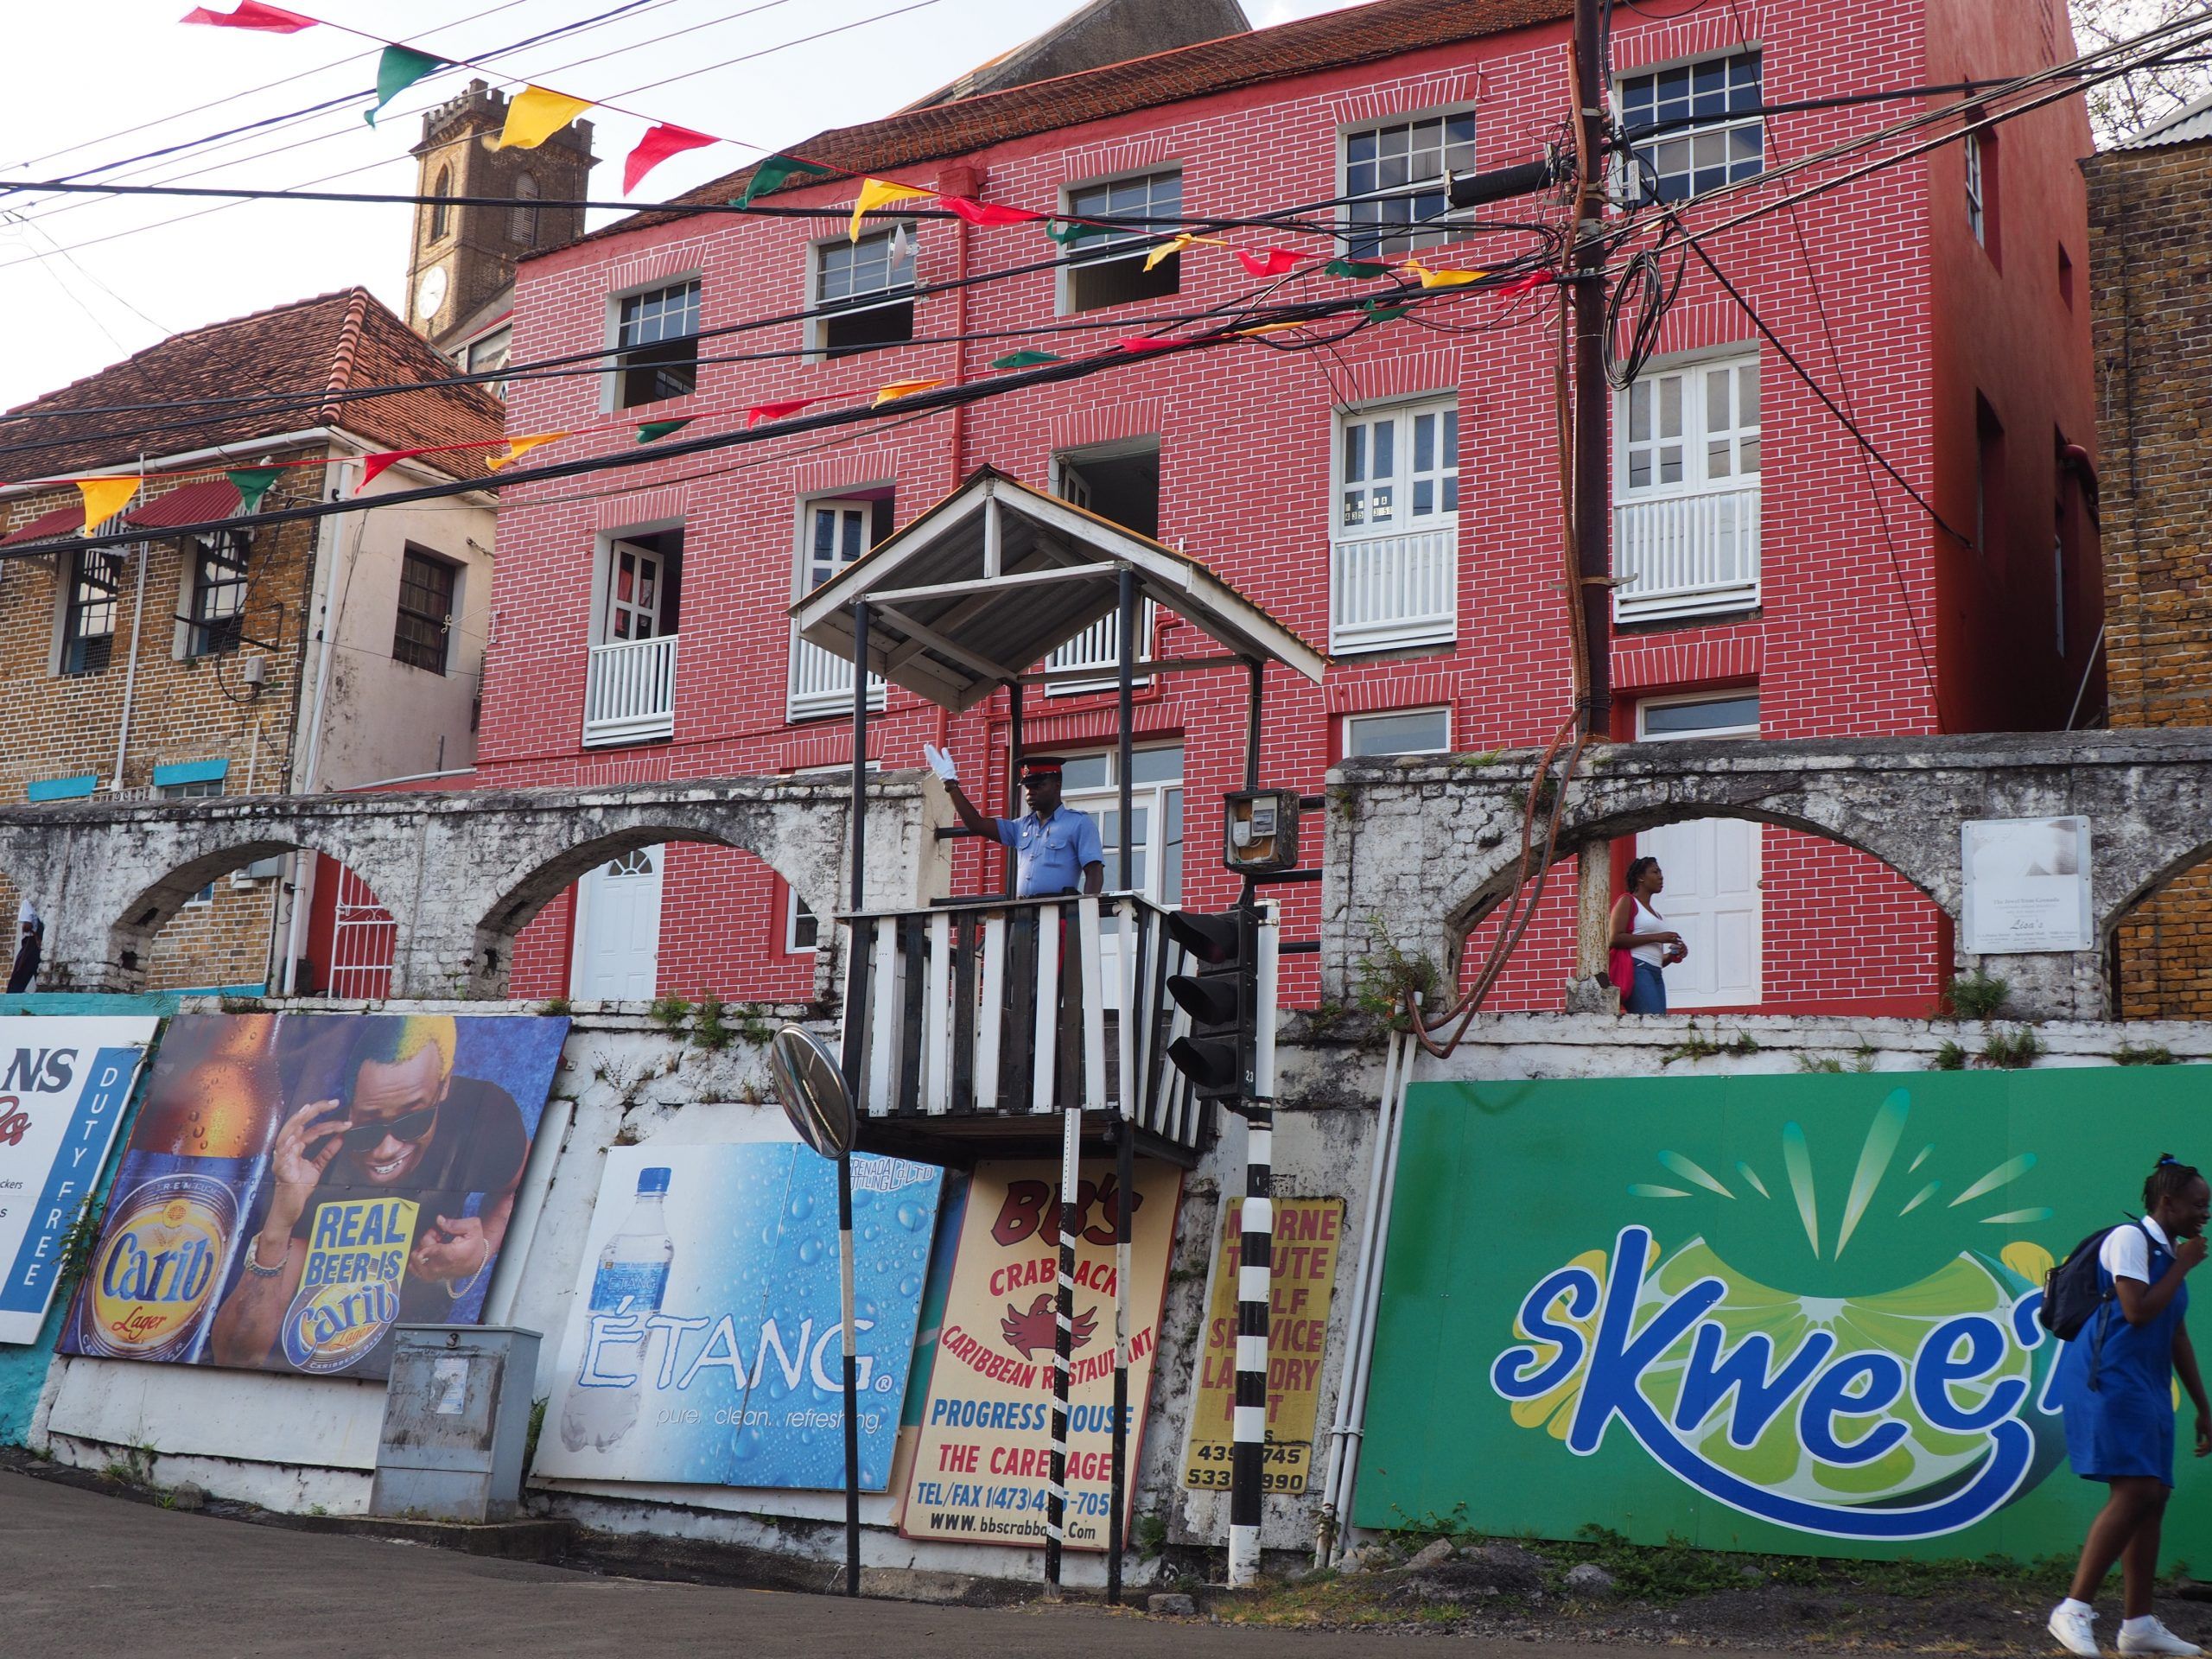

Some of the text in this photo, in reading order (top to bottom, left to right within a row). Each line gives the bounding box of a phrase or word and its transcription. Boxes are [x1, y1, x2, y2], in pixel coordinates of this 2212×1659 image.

[23, 1066, 118, 1287] DUTY FREE
[314, 1203, 406, 1249] REAL
[103, 1231, 213, 1302] Carib
[305, 1249, 404, 1287] BEER IS
[989, 1257, 1117, 1297] CRABACK
[1227, 1247, 1329, 1280] TUTE
[111, 1306, 168, 1340] Lager
[286, 1283, 400, 1366] Carib
[1210, 1318, 1325, 1353] SEVICE
[942, 1325, 1037, 1389] CARIBBEAN
[1201, 1357, 1321, 1391] LADRY
[655, 1405, 883, 1434] pure. clean. refreshng.
[931, 1399, 1047, 1430] PROGRESS
[939, 1444, 1113, 1481] THE CAREAGE
[917, 1482, 983, 1508] TEL/FAX
